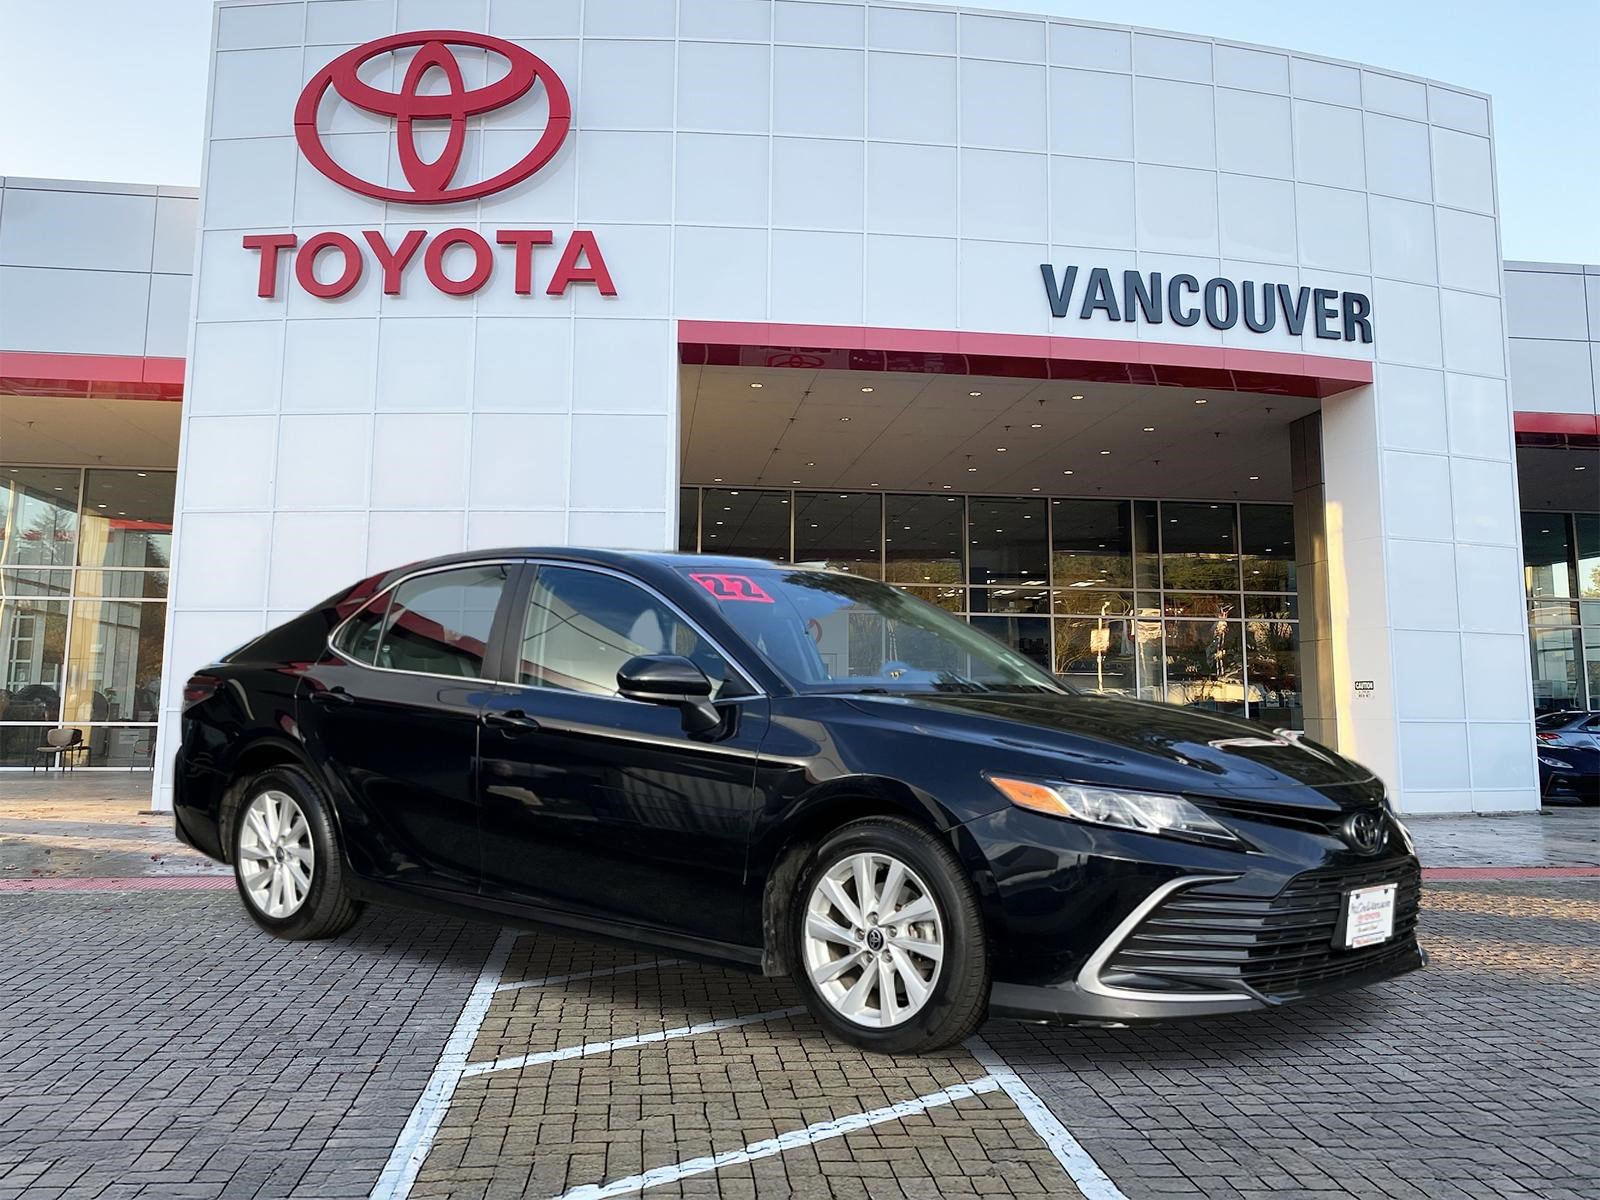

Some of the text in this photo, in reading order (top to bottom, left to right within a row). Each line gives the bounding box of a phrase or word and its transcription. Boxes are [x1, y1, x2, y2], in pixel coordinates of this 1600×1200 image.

[242, 228, 618, 299] TOYOTA
[1040, 263, 1373, 344] VANCOUVER
[697, 575, 765, 599] 22
